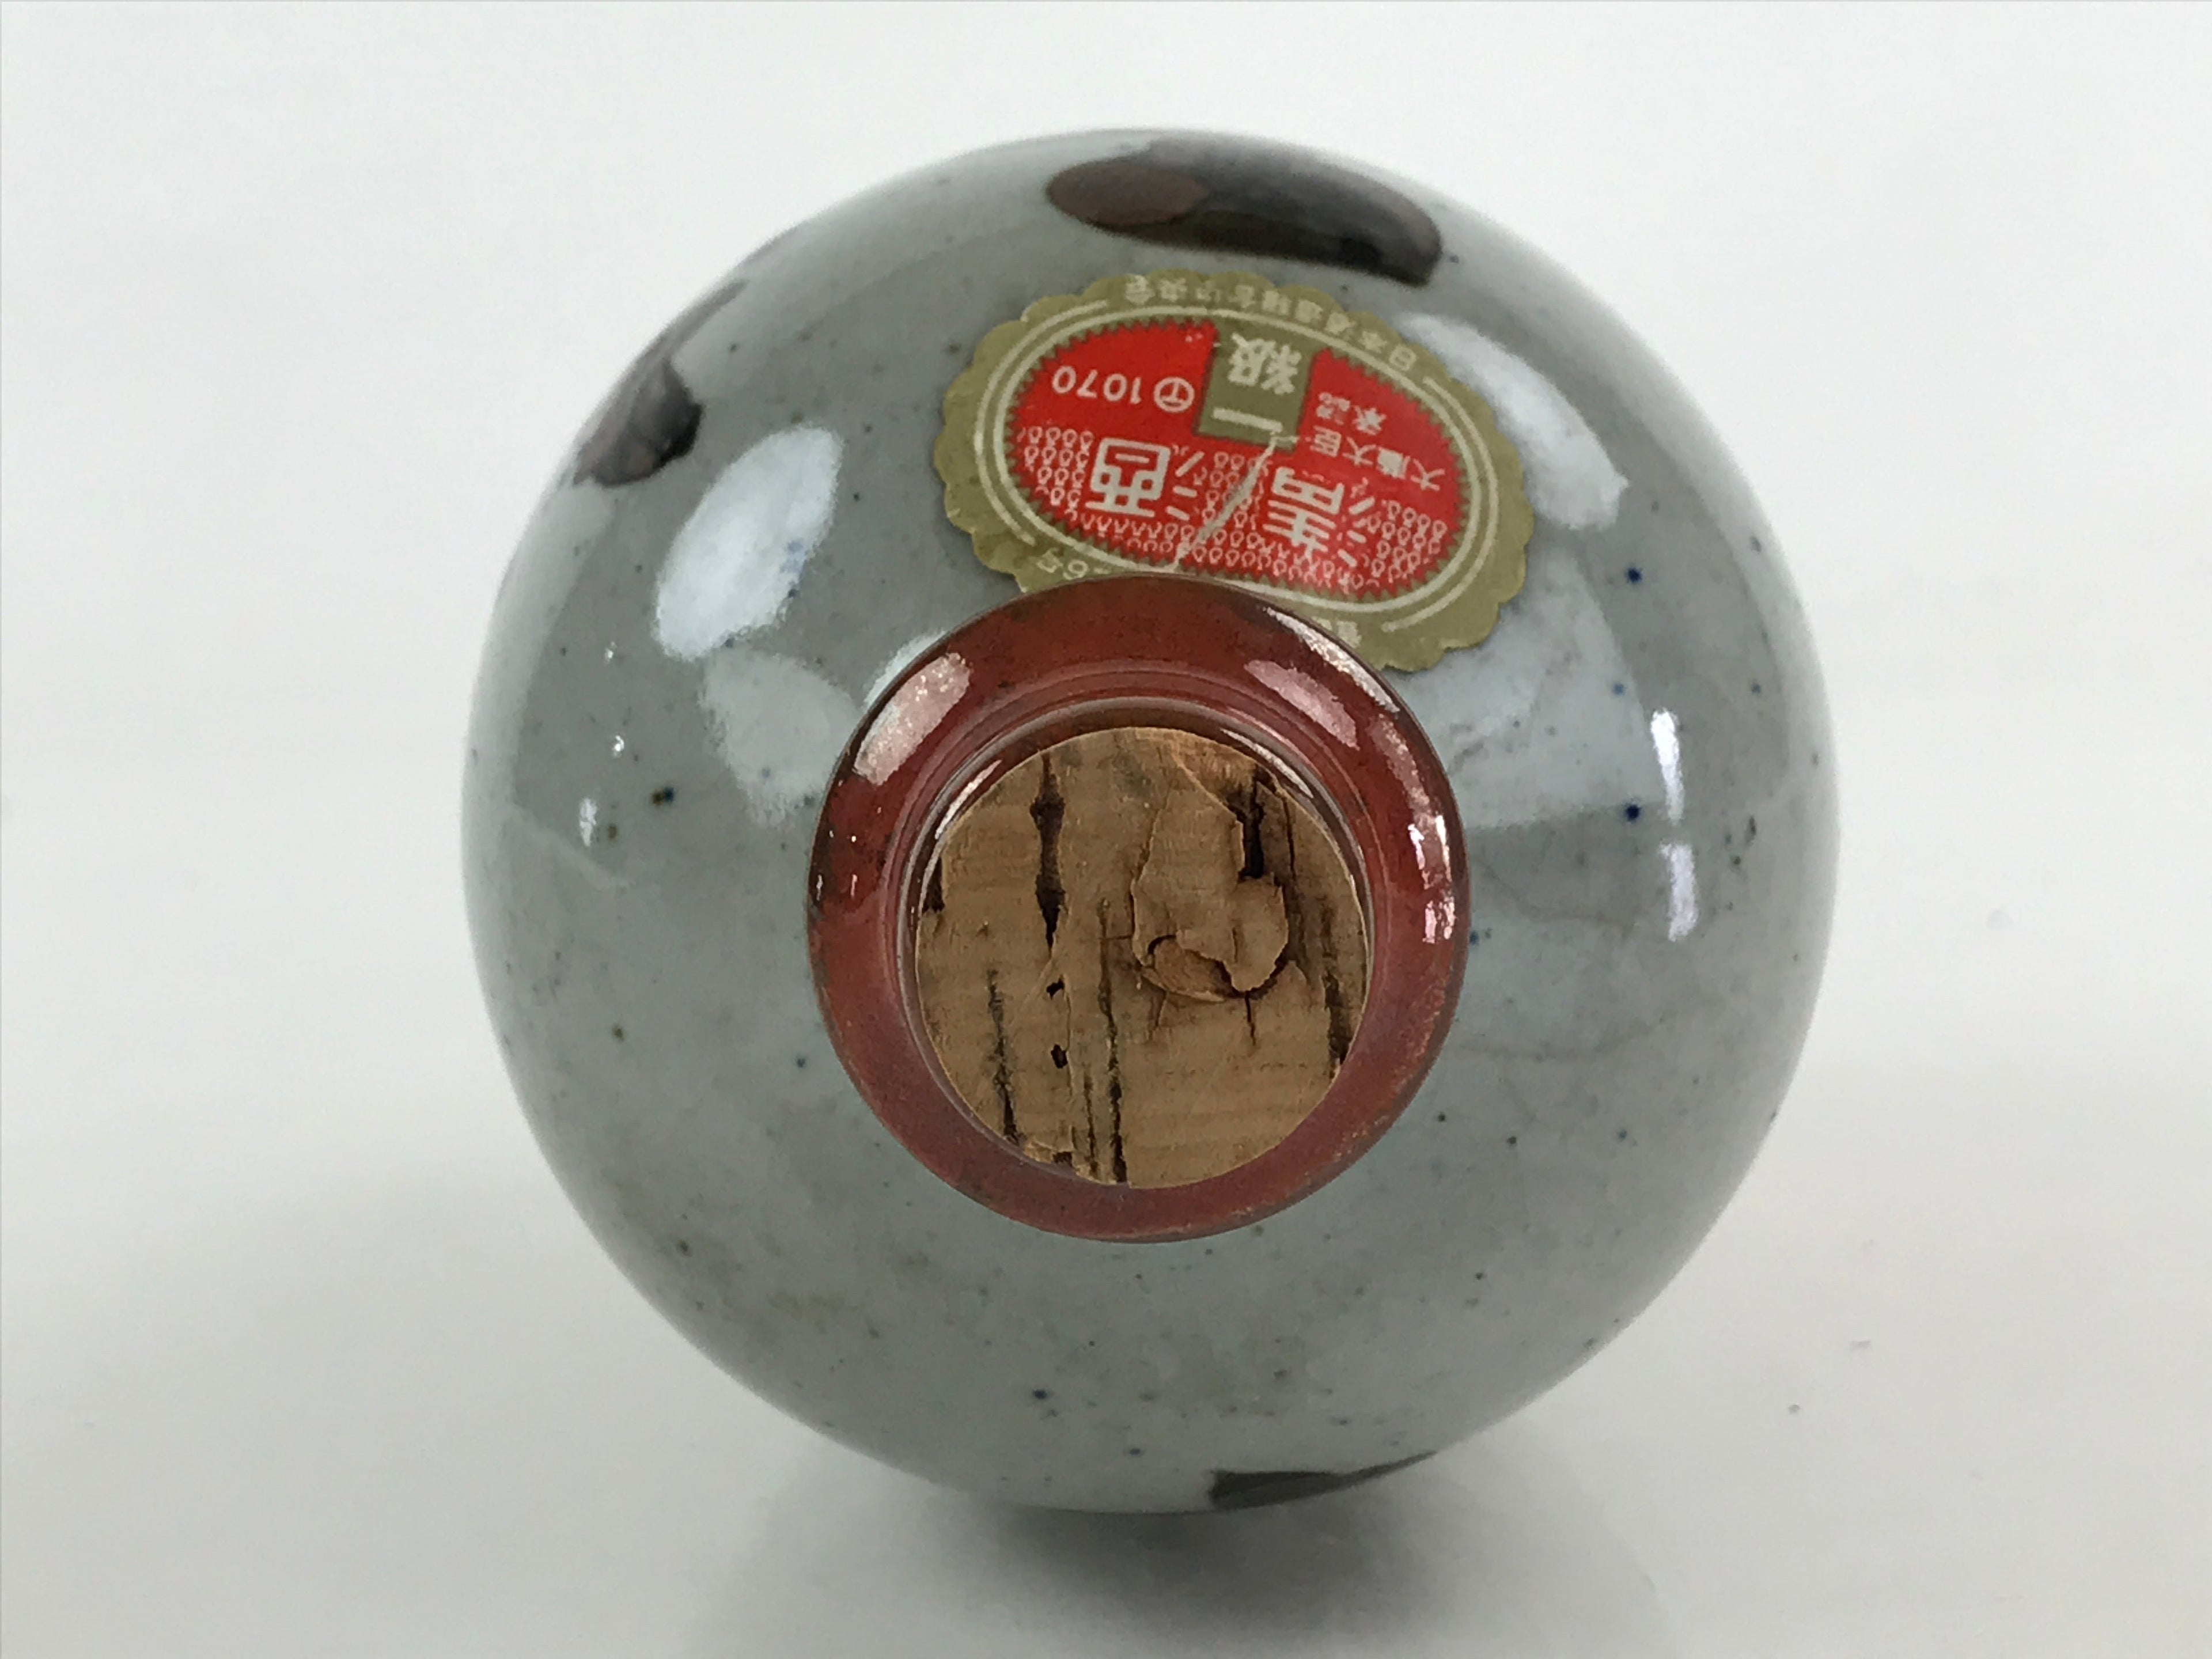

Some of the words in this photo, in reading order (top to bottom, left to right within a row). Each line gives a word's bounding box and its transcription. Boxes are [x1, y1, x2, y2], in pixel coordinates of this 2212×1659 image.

[1051, 365, 1142, 404] 1070
[1212, 332, 1303, 433] 一級
[1084, 437, 1376, 567] 清酒
